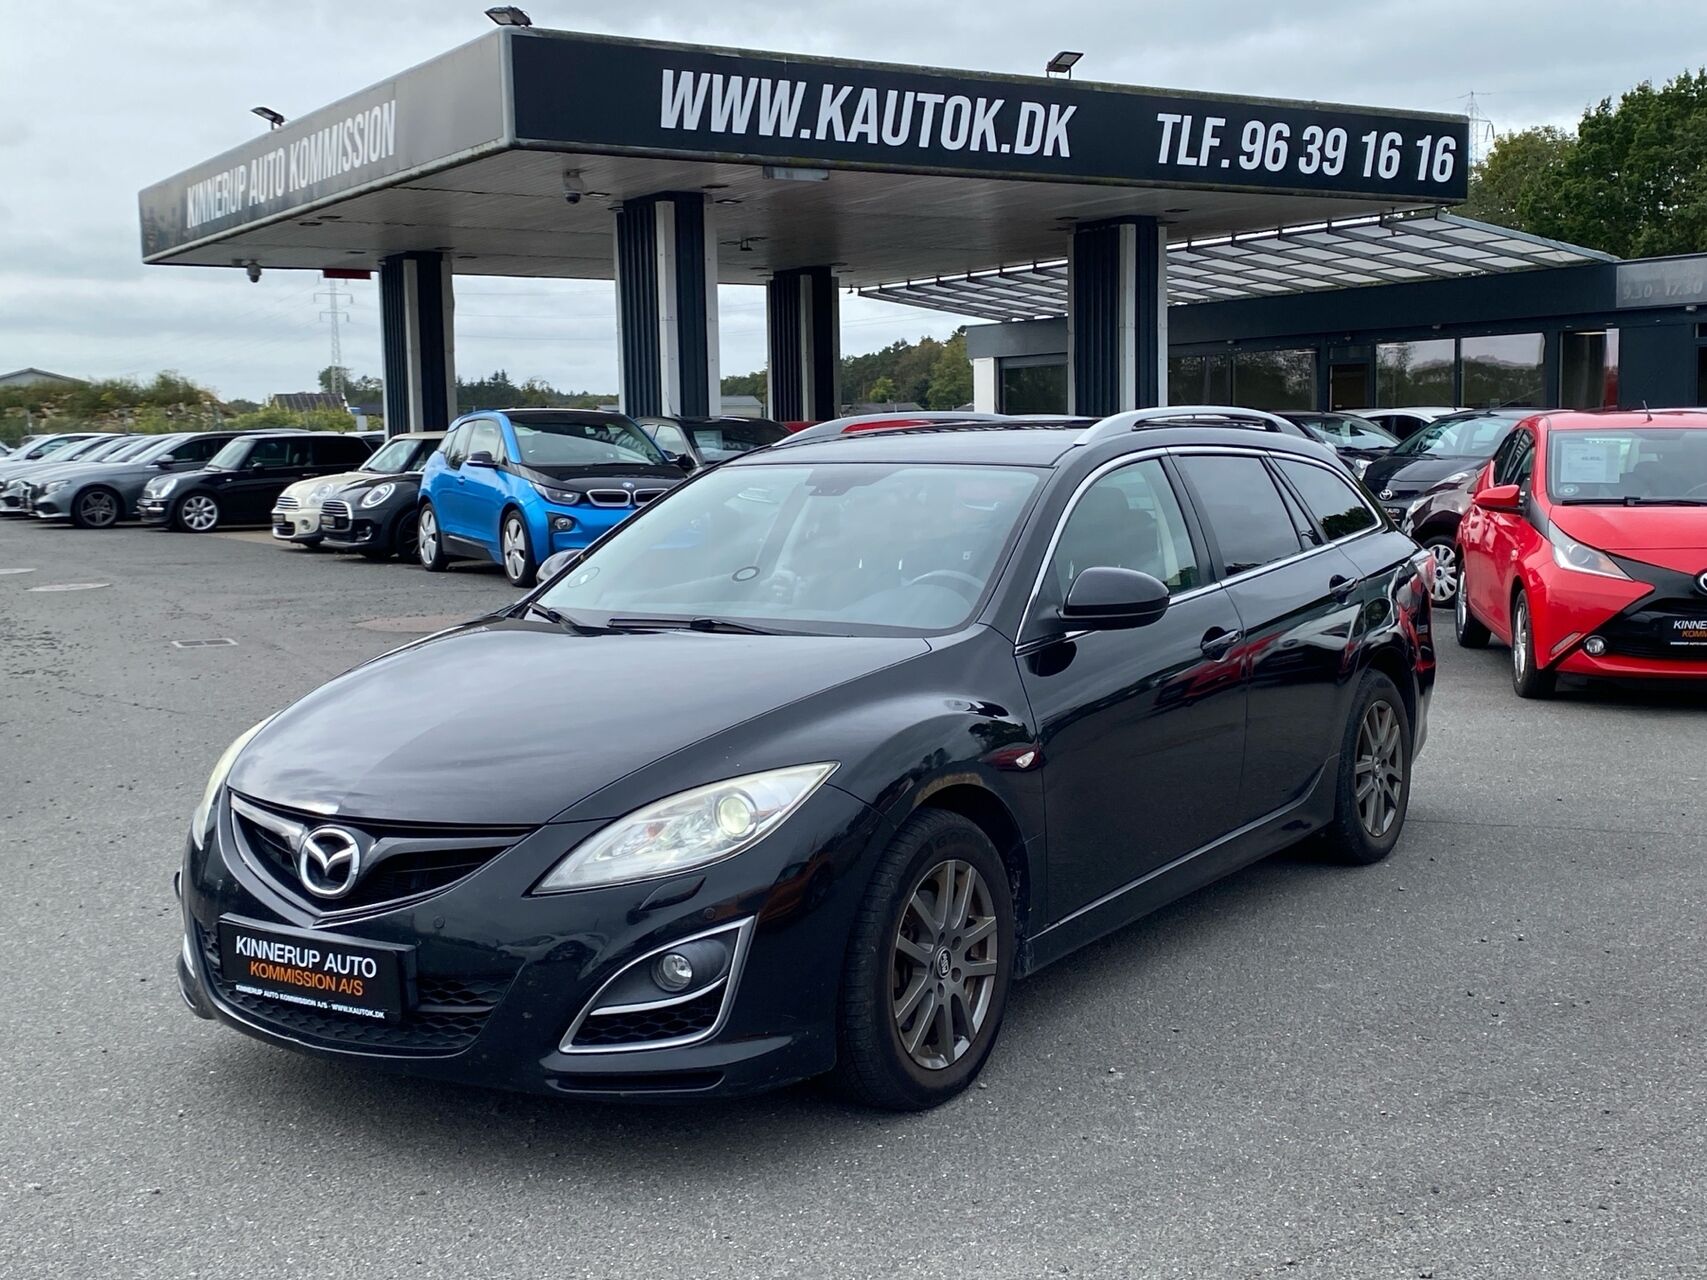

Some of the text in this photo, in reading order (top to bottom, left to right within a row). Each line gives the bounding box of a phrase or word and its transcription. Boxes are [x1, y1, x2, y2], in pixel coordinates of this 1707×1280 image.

[660, 69, 1078, 158] WWW.KAUTOK.DK
[186, 99, 396, 229] KINNERUP AUTO KOMMISSION
[1157, 113, 1457, 183] TLF. 96 39 16 16
[235, 935, 377, 979] KINNERUP AUTO
[249, 960, 364, 996] KOMMISSION A/S
[263, 990, 279, 999] AUTO
